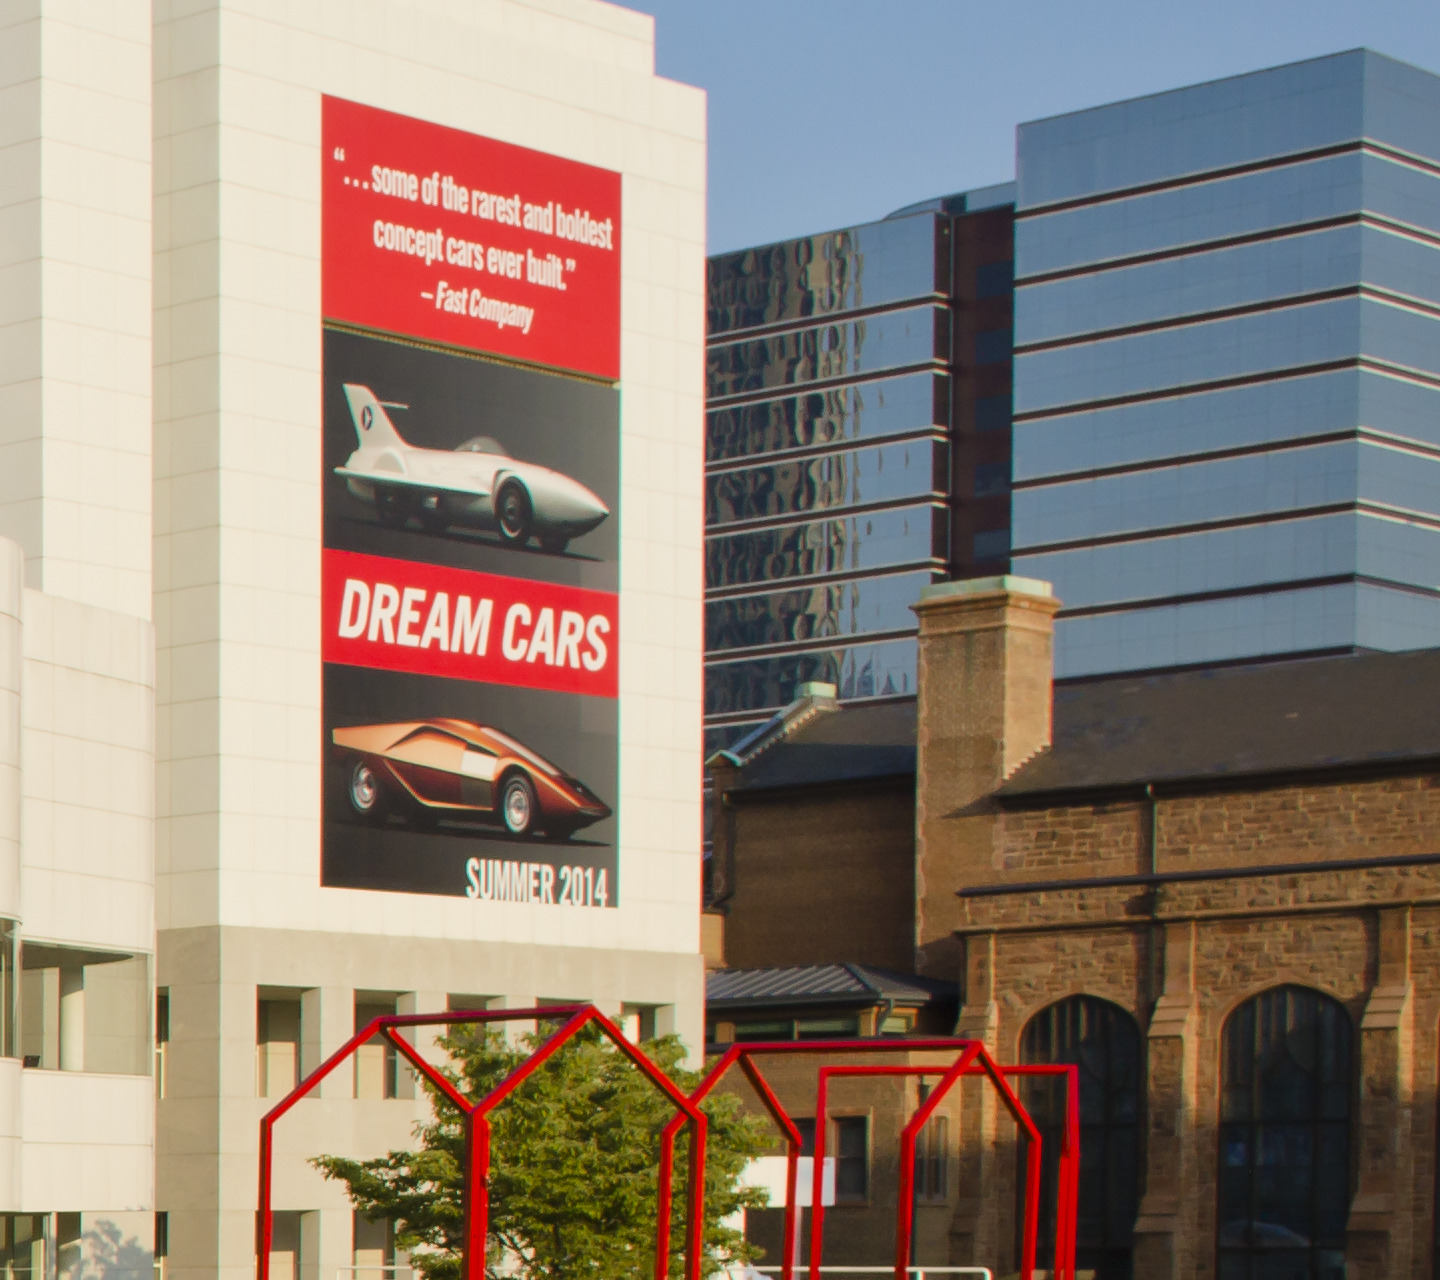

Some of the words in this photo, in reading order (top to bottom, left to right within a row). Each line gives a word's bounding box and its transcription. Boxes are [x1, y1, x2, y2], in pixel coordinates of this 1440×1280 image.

[422, 172, 438, 206] of
[441, 176, 468, 214] the
[472, 190, 521, 227] rarest
[524, 201, 553, 236] and
[556, 204, 612, 250] boldest
[374, 220, 443, 266] concept
[446, 237, 484, 271] cars
[487, 246, 524, 280] ever
[436, 280, 468, 316] Fast
[470, 288, 534, 335] Company
[338, 578, 493, 656] DREAM
[502, 603, 610, 672] CARS
[466, 857, 556, 904] SUMMER
[559, 865, 608, 907] 2014
